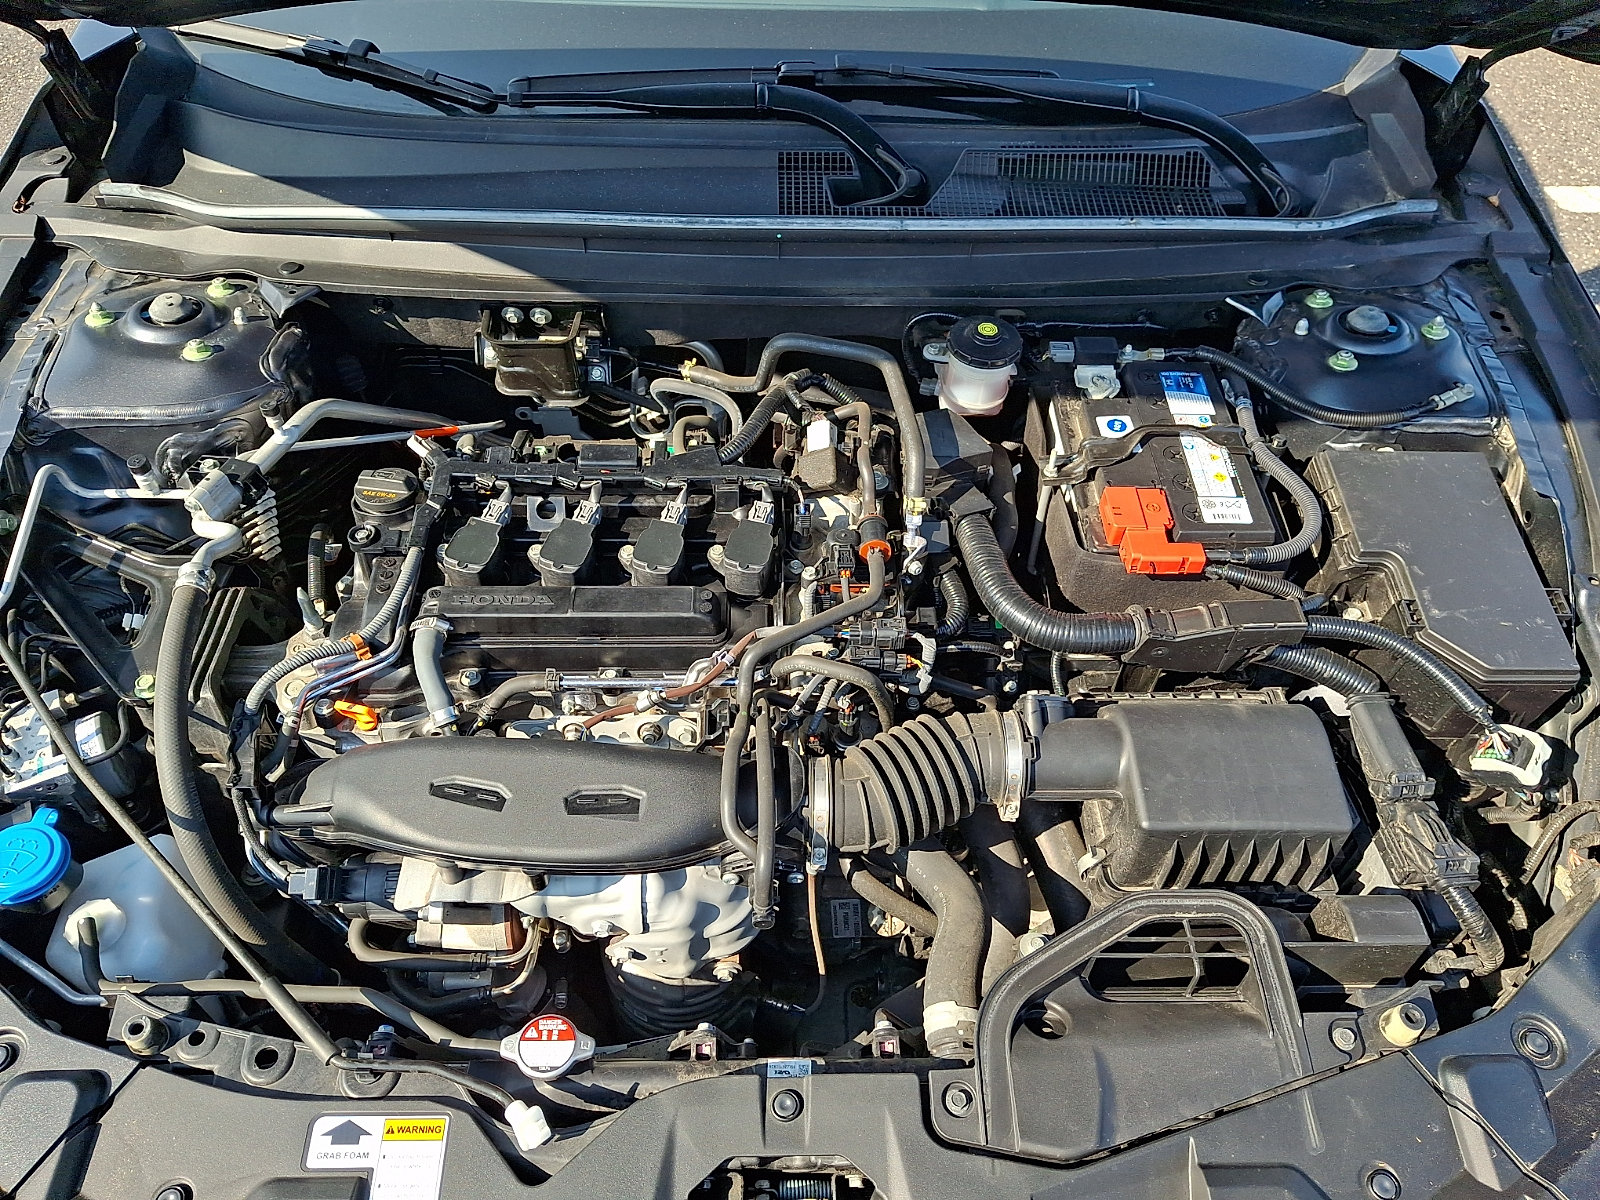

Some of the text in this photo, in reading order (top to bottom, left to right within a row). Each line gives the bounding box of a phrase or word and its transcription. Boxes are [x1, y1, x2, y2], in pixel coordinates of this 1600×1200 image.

[451, 595, 554, 605] HONDA
[397, 1125, 442, 1134] WARNING
[316, 1151, 370, 1160] GRAB FOAM
